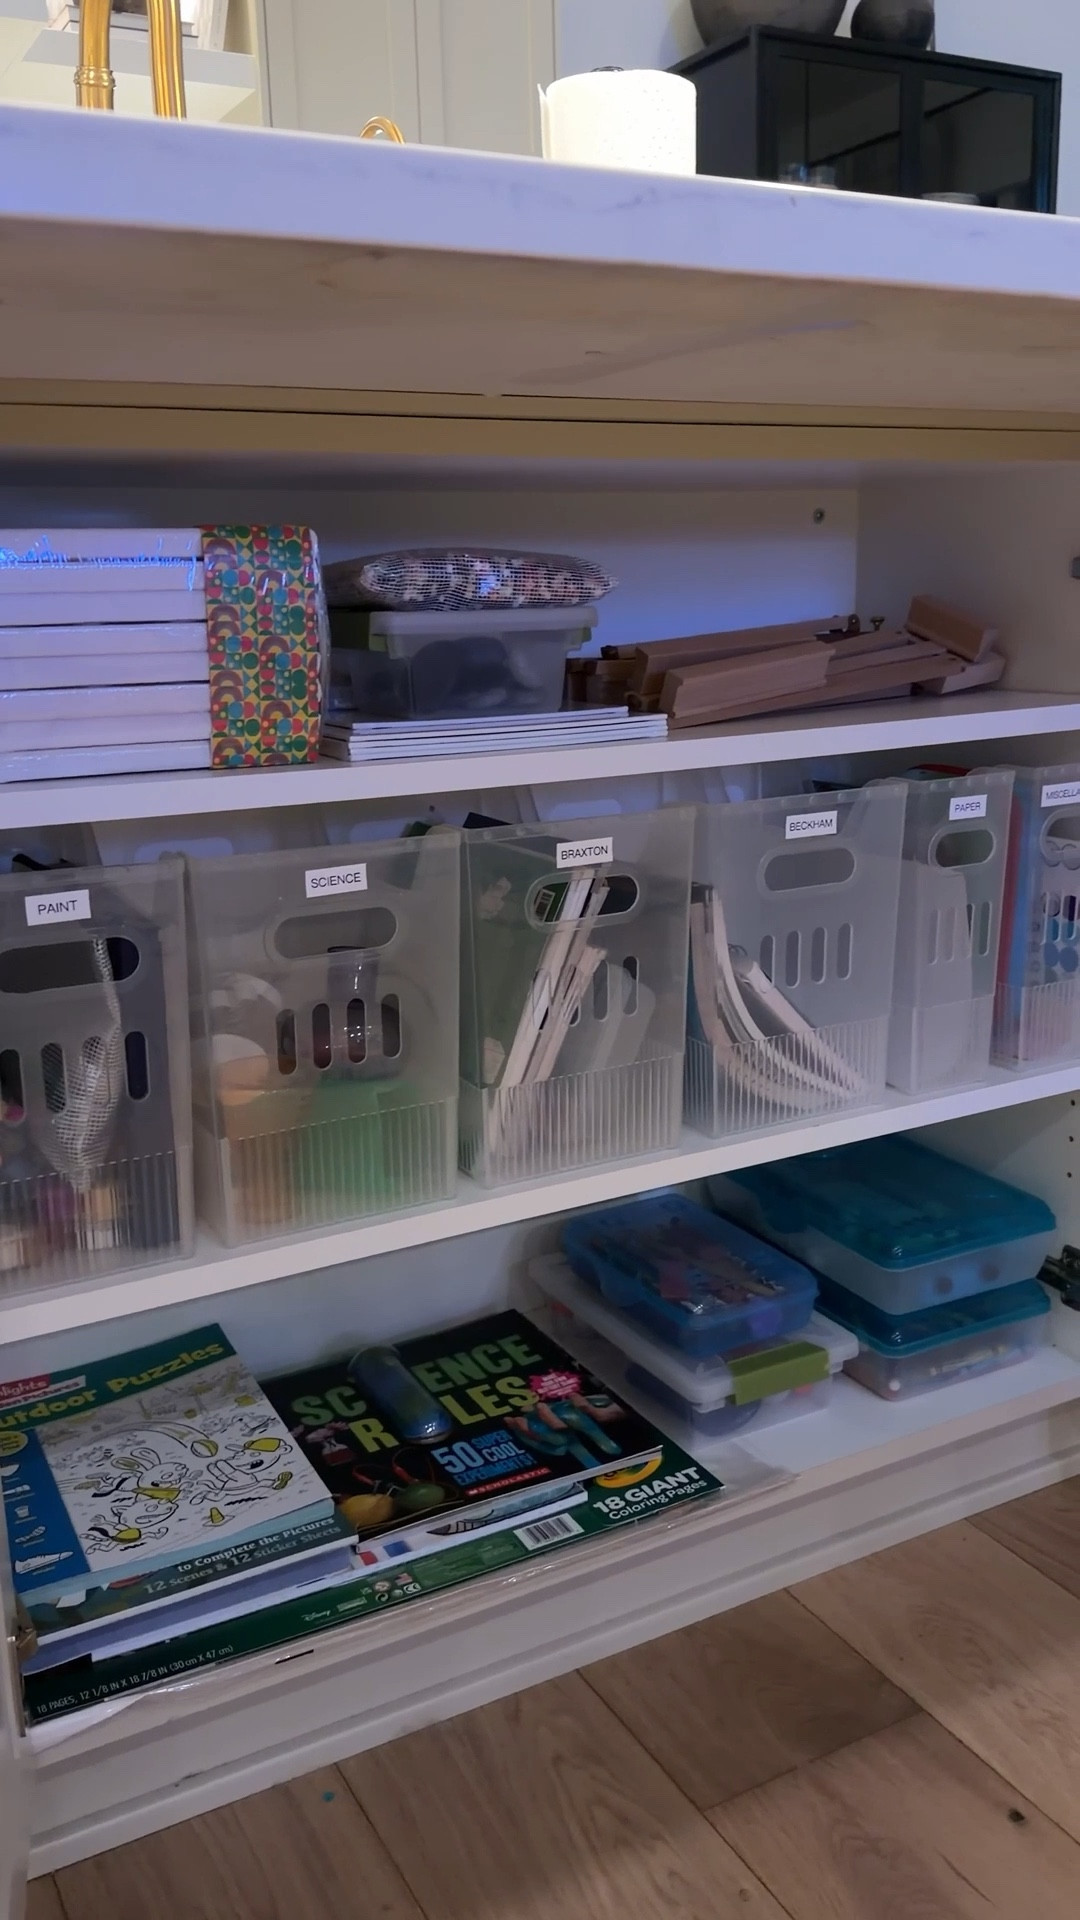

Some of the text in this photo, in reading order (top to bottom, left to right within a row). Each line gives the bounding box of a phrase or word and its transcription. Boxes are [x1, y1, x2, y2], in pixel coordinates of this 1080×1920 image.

[954, 801, 981, 812] PAPER
[789, 818, 834, 832] BECKHAM
[561, 846, 609, 860] BRAXTON
[310, 872, 362, 889] SCIENCE
[37, 899, 78, 915] PAINT
[105, 1343, 224, 1393] Puzzles
[291, 1334, 543, 1426] SCENCE
[471, 1429, 513, 1449] SUPER
[481, 1441, 526, 1462] COOL
[431, 1441, 485, 1474] 50
[453, 1453, 538, 1486] EXPERIMENTS!
[477, 1467, 551, 1493] SCHOLASTIC
[592, 1466, 701, 1513] 18 GIANT
[608, 1479, 708, 1520] Coloring Pages
[144, 1579, 168, 1594] 12
[215, 1562, 228, 1572] &
[229, 1552, 253, 1567] 12
[253, 1538, 299, 1559] Sticker
[299, 1526, 342, 1543] Sheets
[177, 1517, 336, 1574] to Complete the Pictures
[36, 1644, 234, 1715] 18 PAGES, 12 1/8 IN X 18 7/8 IN (30 cm X 47 cm)
